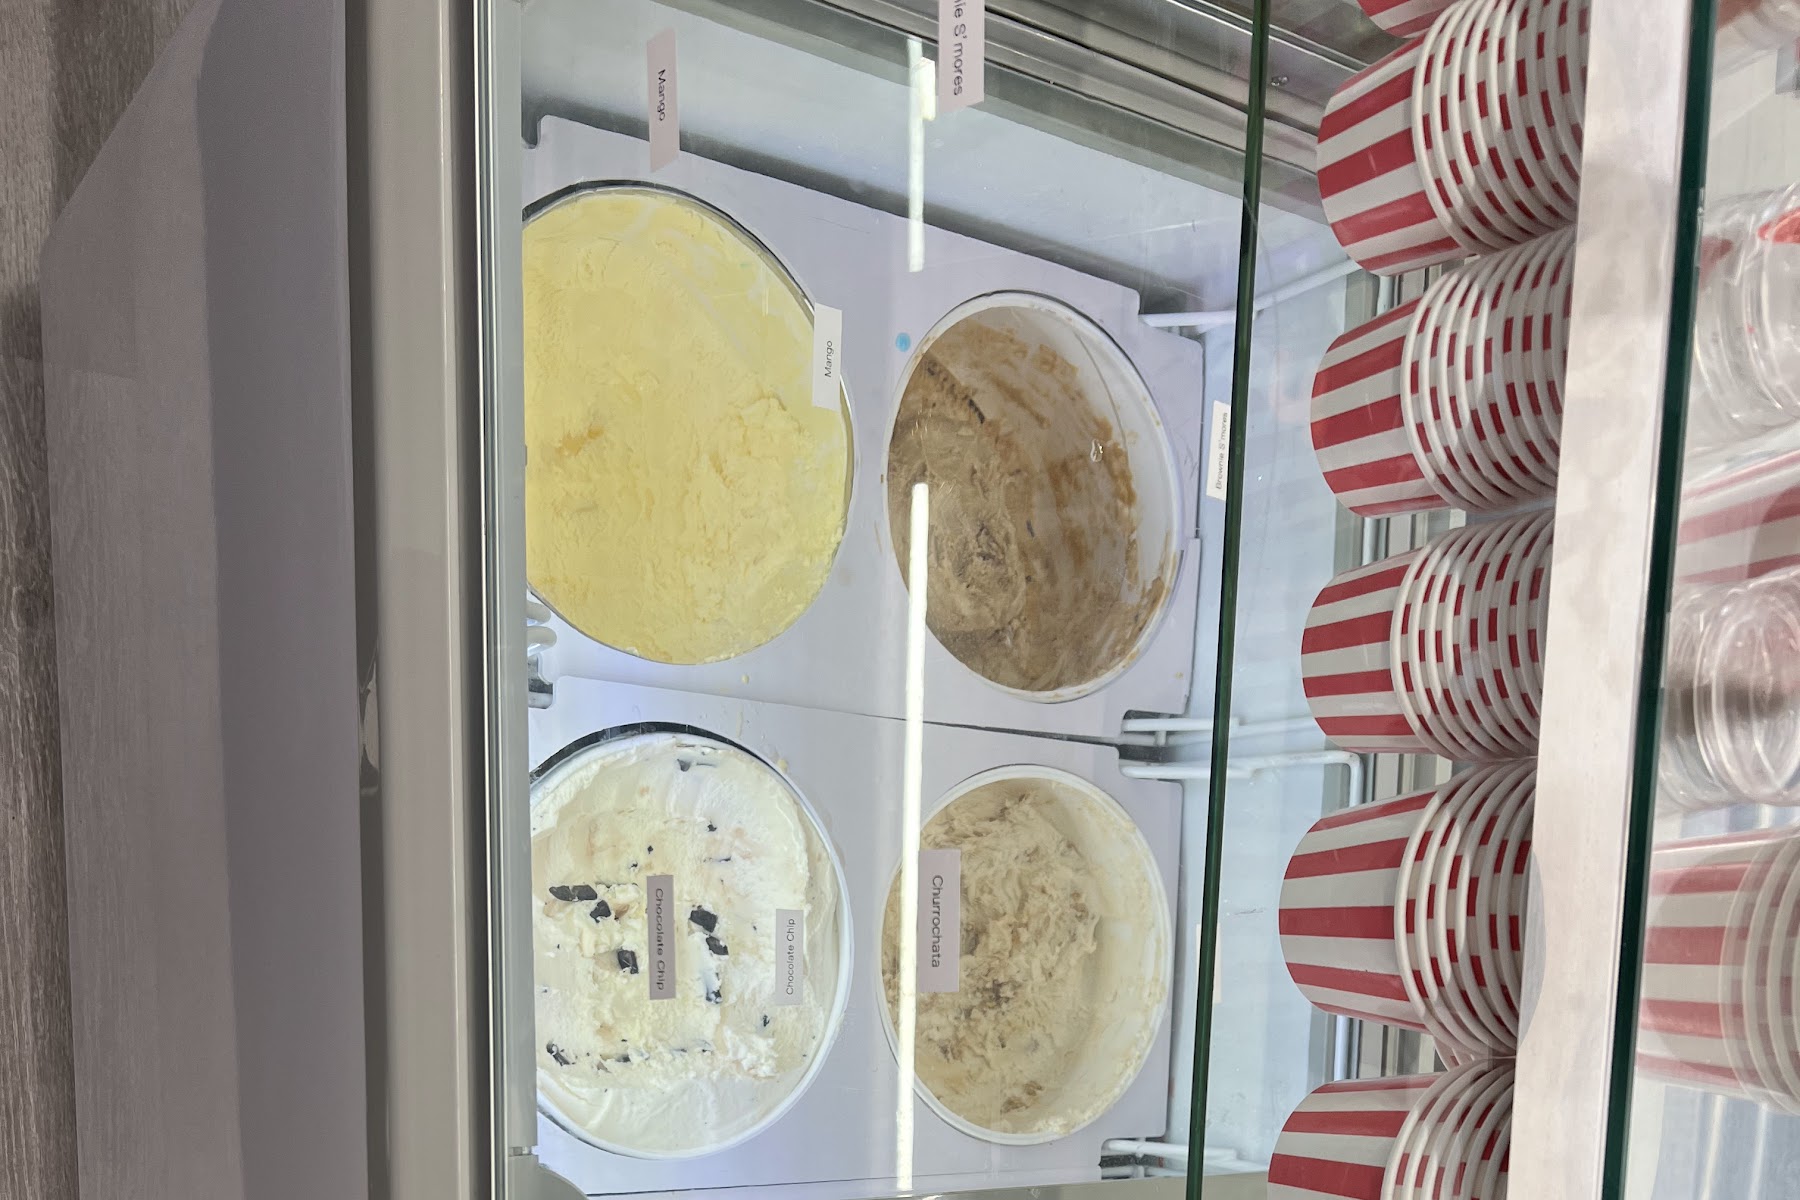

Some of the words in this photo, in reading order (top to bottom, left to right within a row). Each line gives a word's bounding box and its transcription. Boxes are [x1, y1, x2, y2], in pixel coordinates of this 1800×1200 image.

[657, 69, 666, 122] Mango
[824, 340, 834, 378] Mango
[656, 888, 664, 956] Chocolate
[786, 918, 795, 942] Chip
[931, 874, 944, 968] Churrochata
[656, 959, 666, 990] Chip
[786, 945, 794, 995] Chocolate
